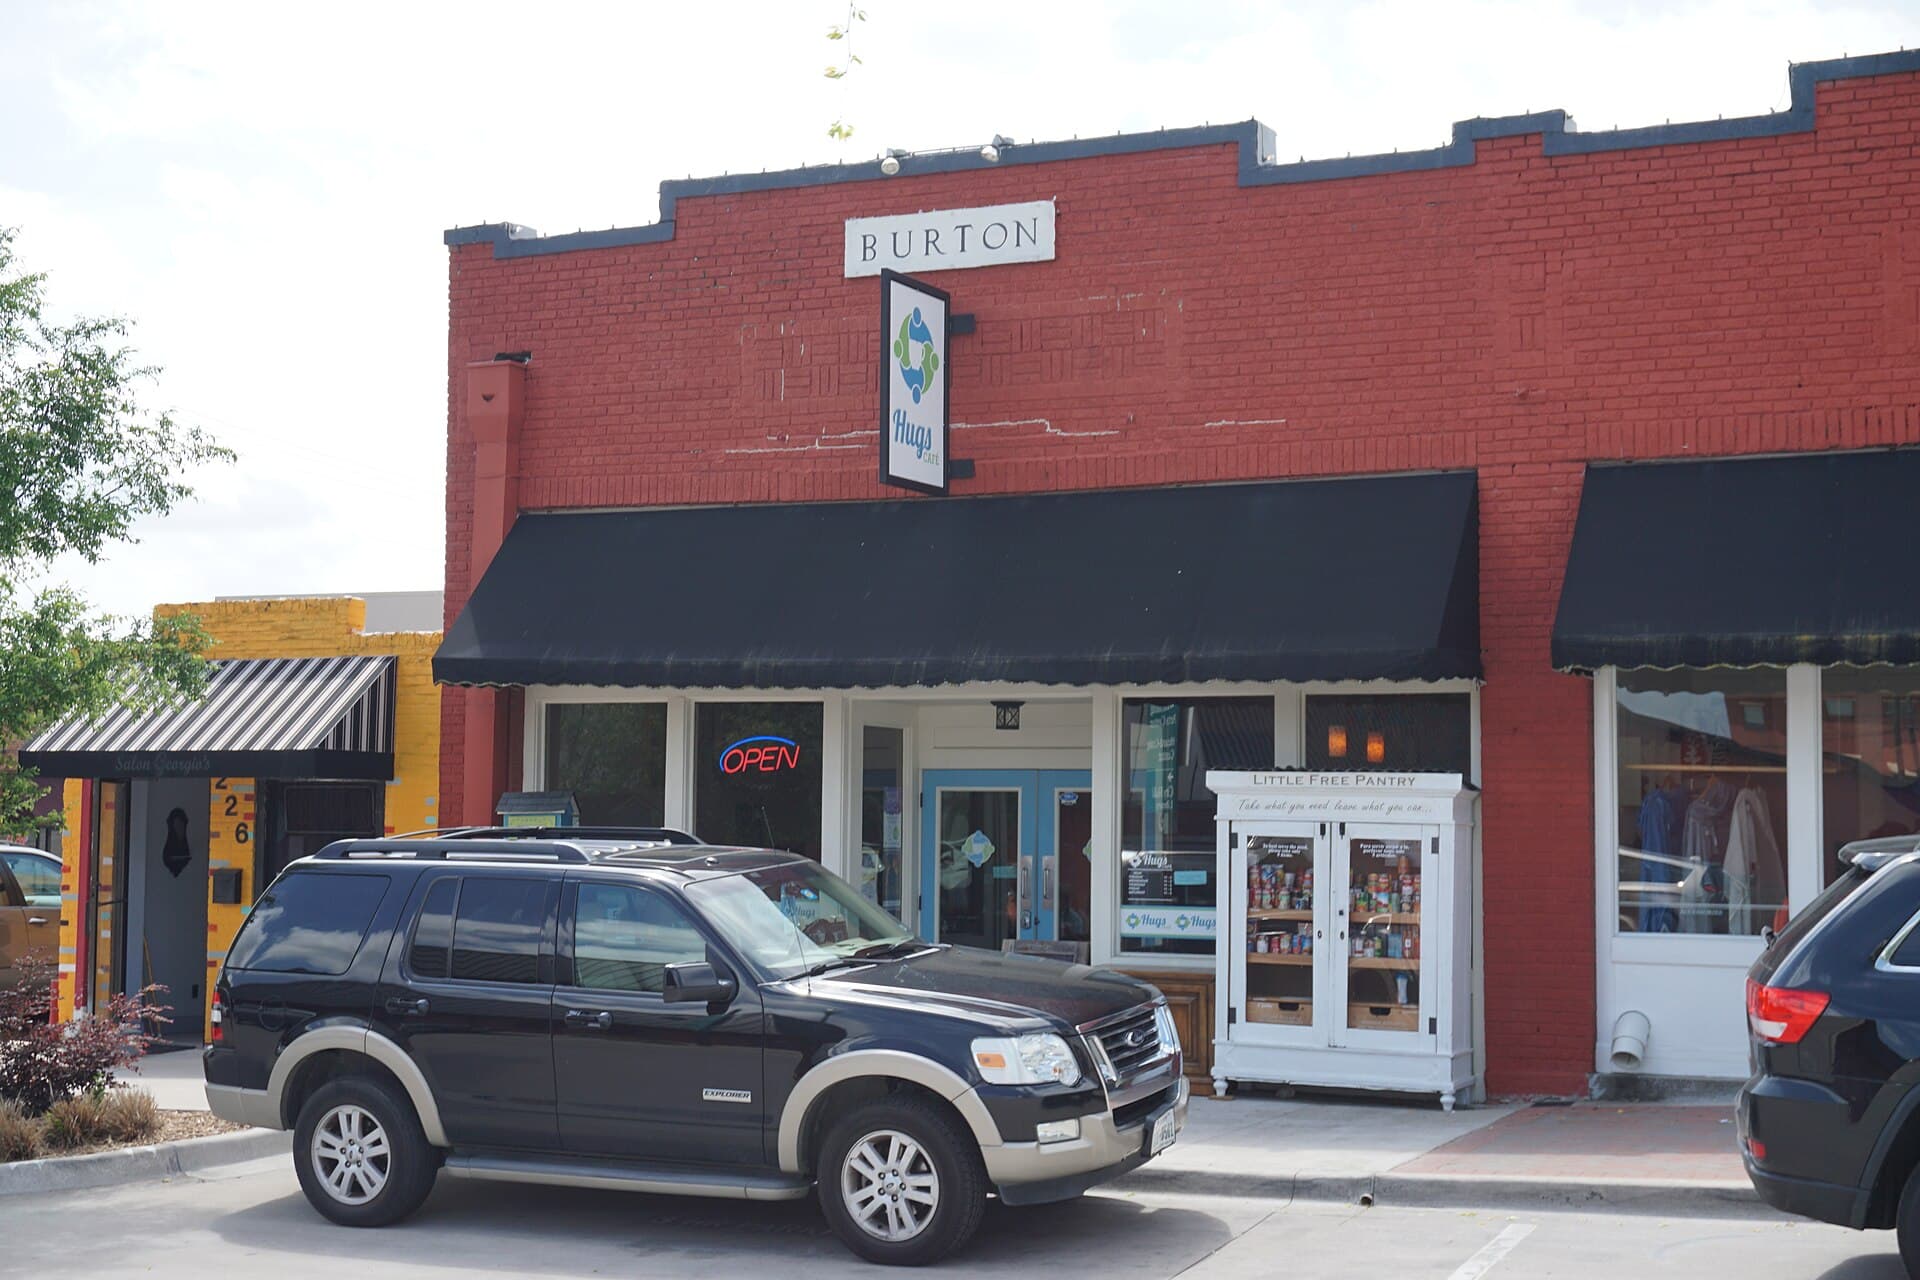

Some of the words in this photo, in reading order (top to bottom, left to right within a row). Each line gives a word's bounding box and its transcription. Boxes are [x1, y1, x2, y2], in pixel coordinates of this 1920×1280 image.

[861, 217, 1038, 262] BURTON
[893, 409, 931, 459] Hugs
[115, 754, 150, 771] Salon
[723, 744, 800, 774] OPEN
[1253, 774, 1304, 785] LITTLE
[1309, 774, 1350, 786] FREE
[1355, 775, 1416, 787] PANTRY
[1239, 800, 1260, 810] Take
[1265, 800, 1286, 810] what
[1288, 802, 1304, 815] you
[1309, 800, 1330, 810] need
[1334, 800, 1357, 811] leave
[1361, 800, 1385, 811] what
[1385, 803, 1403, 815] you
[1142, 854, 1168, 868] Hugs
[1141, 914, 1167, 929] Hugs
[1190, 915, 1216, 930] Hugs
[704, 1090, 750, 1099] EXPLORER
